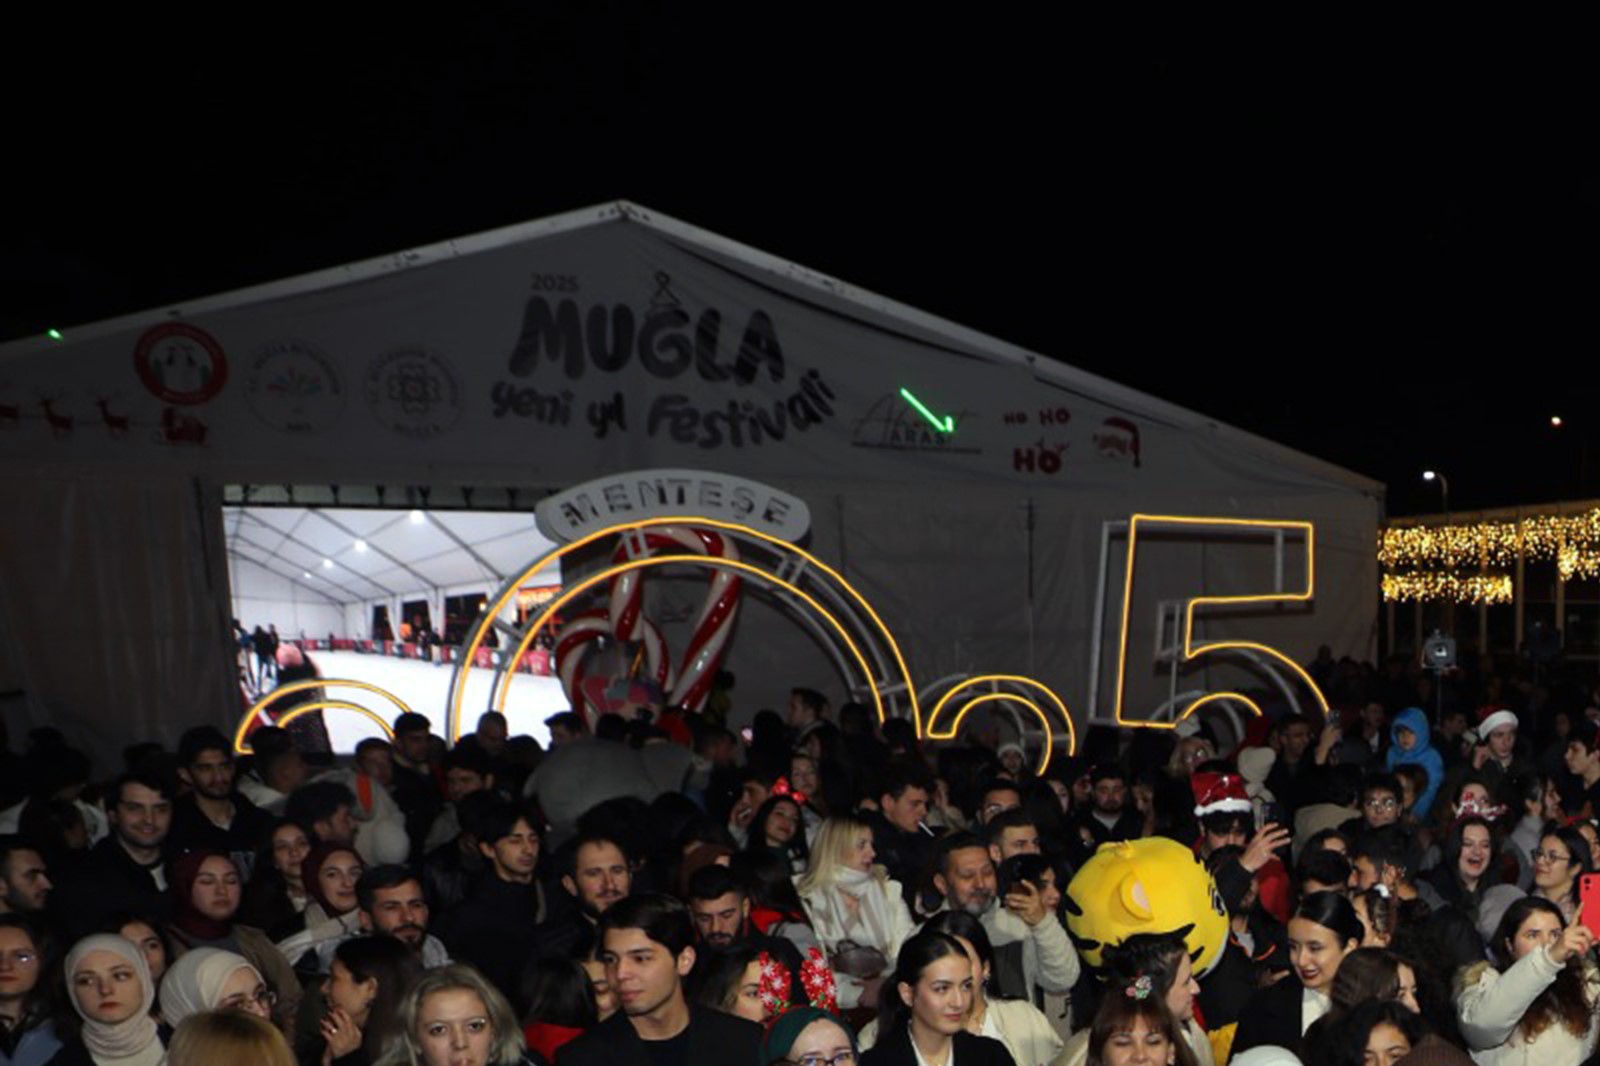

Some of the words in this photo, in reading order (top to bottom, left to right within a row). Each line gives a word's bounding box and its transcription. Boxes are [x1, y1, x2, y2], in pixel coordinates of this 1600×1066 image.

[530, 273, 579, 292] 2025
[491, 381, 574, 427] yeni
[647, 368, 836, 449] Festivali
[1003, 411, 1028, 425] HO
[1039, 408, 1071, 426] HO
[1013, 448, 1062, 475] HO
